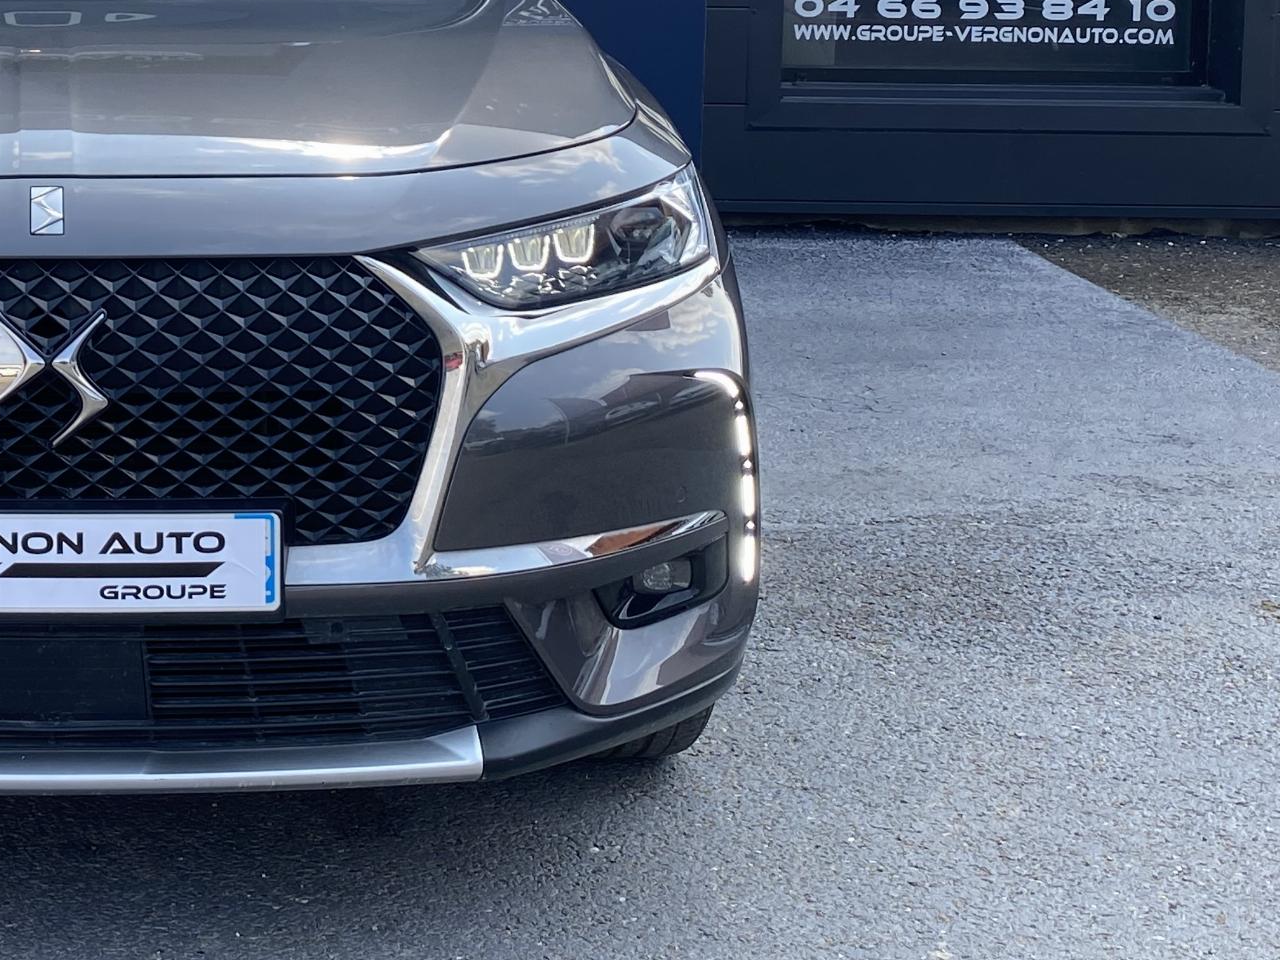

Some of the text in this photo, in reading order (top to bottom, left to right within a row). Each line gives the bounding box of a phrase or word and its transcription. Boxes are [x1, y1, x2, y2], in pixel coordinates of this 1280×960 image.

[793, 23, 1175, 45] WWW.GROUPE-VERGNONAUTO.COM
[98, 531, 226, 555] AUTO
[99, 583, 227, 600] GROUPE
